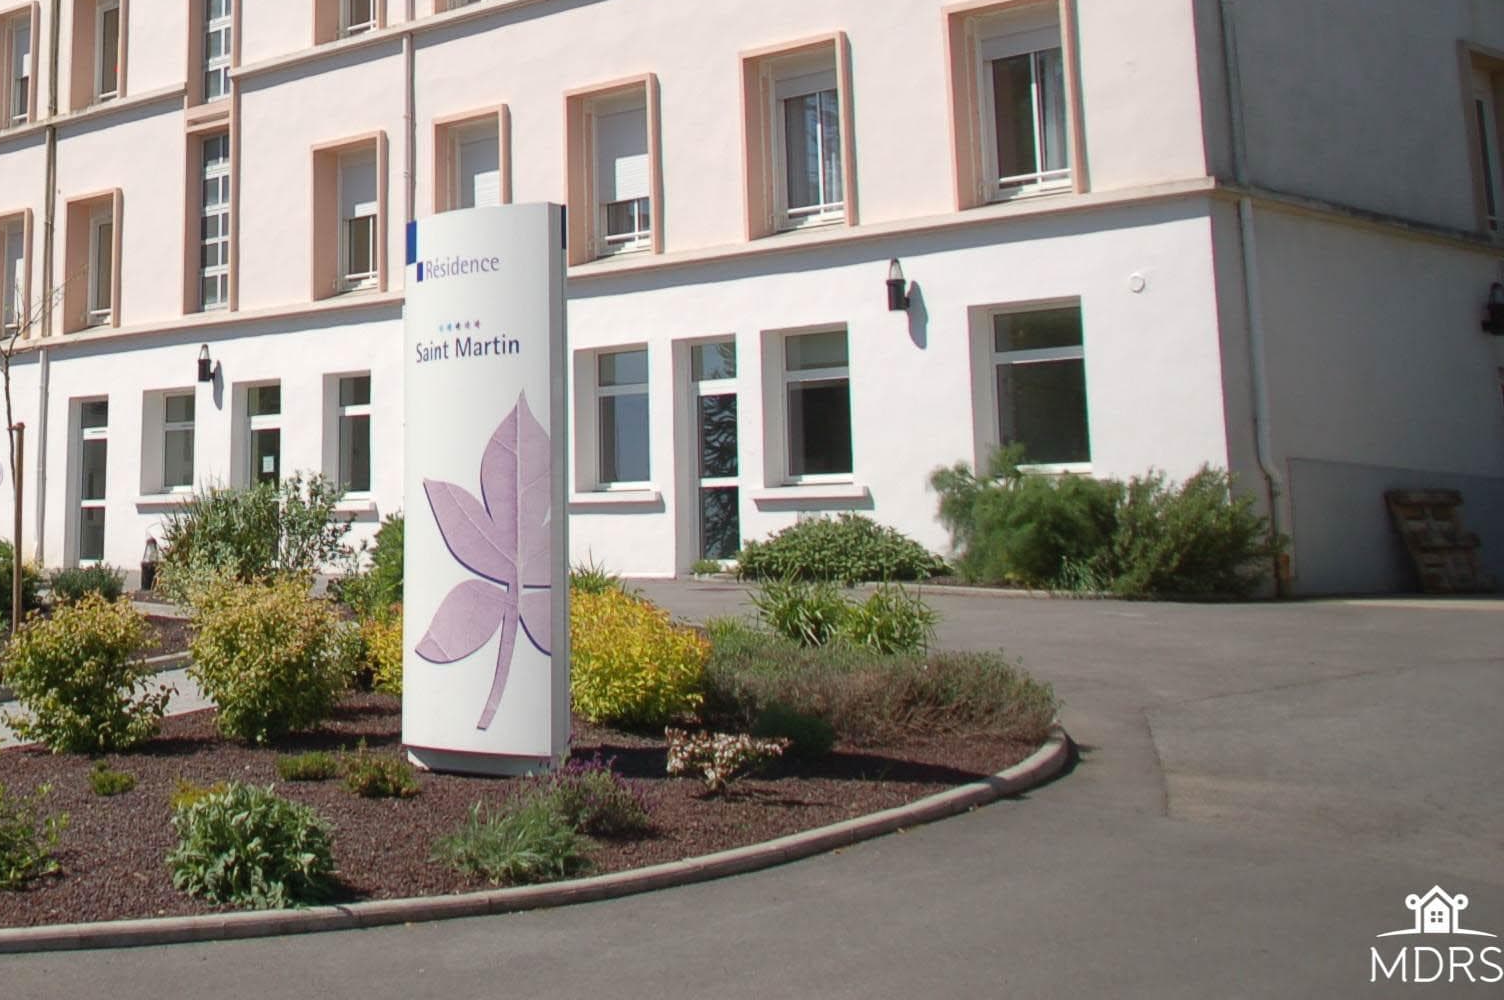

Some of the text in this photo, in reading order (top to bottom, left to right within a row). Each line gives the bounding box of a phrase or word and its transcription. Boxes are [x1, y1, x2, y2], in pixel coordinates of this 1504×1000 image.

[426, 256, 500, 280] Résidence
[416, 333, 520, 363] Saint Martin
